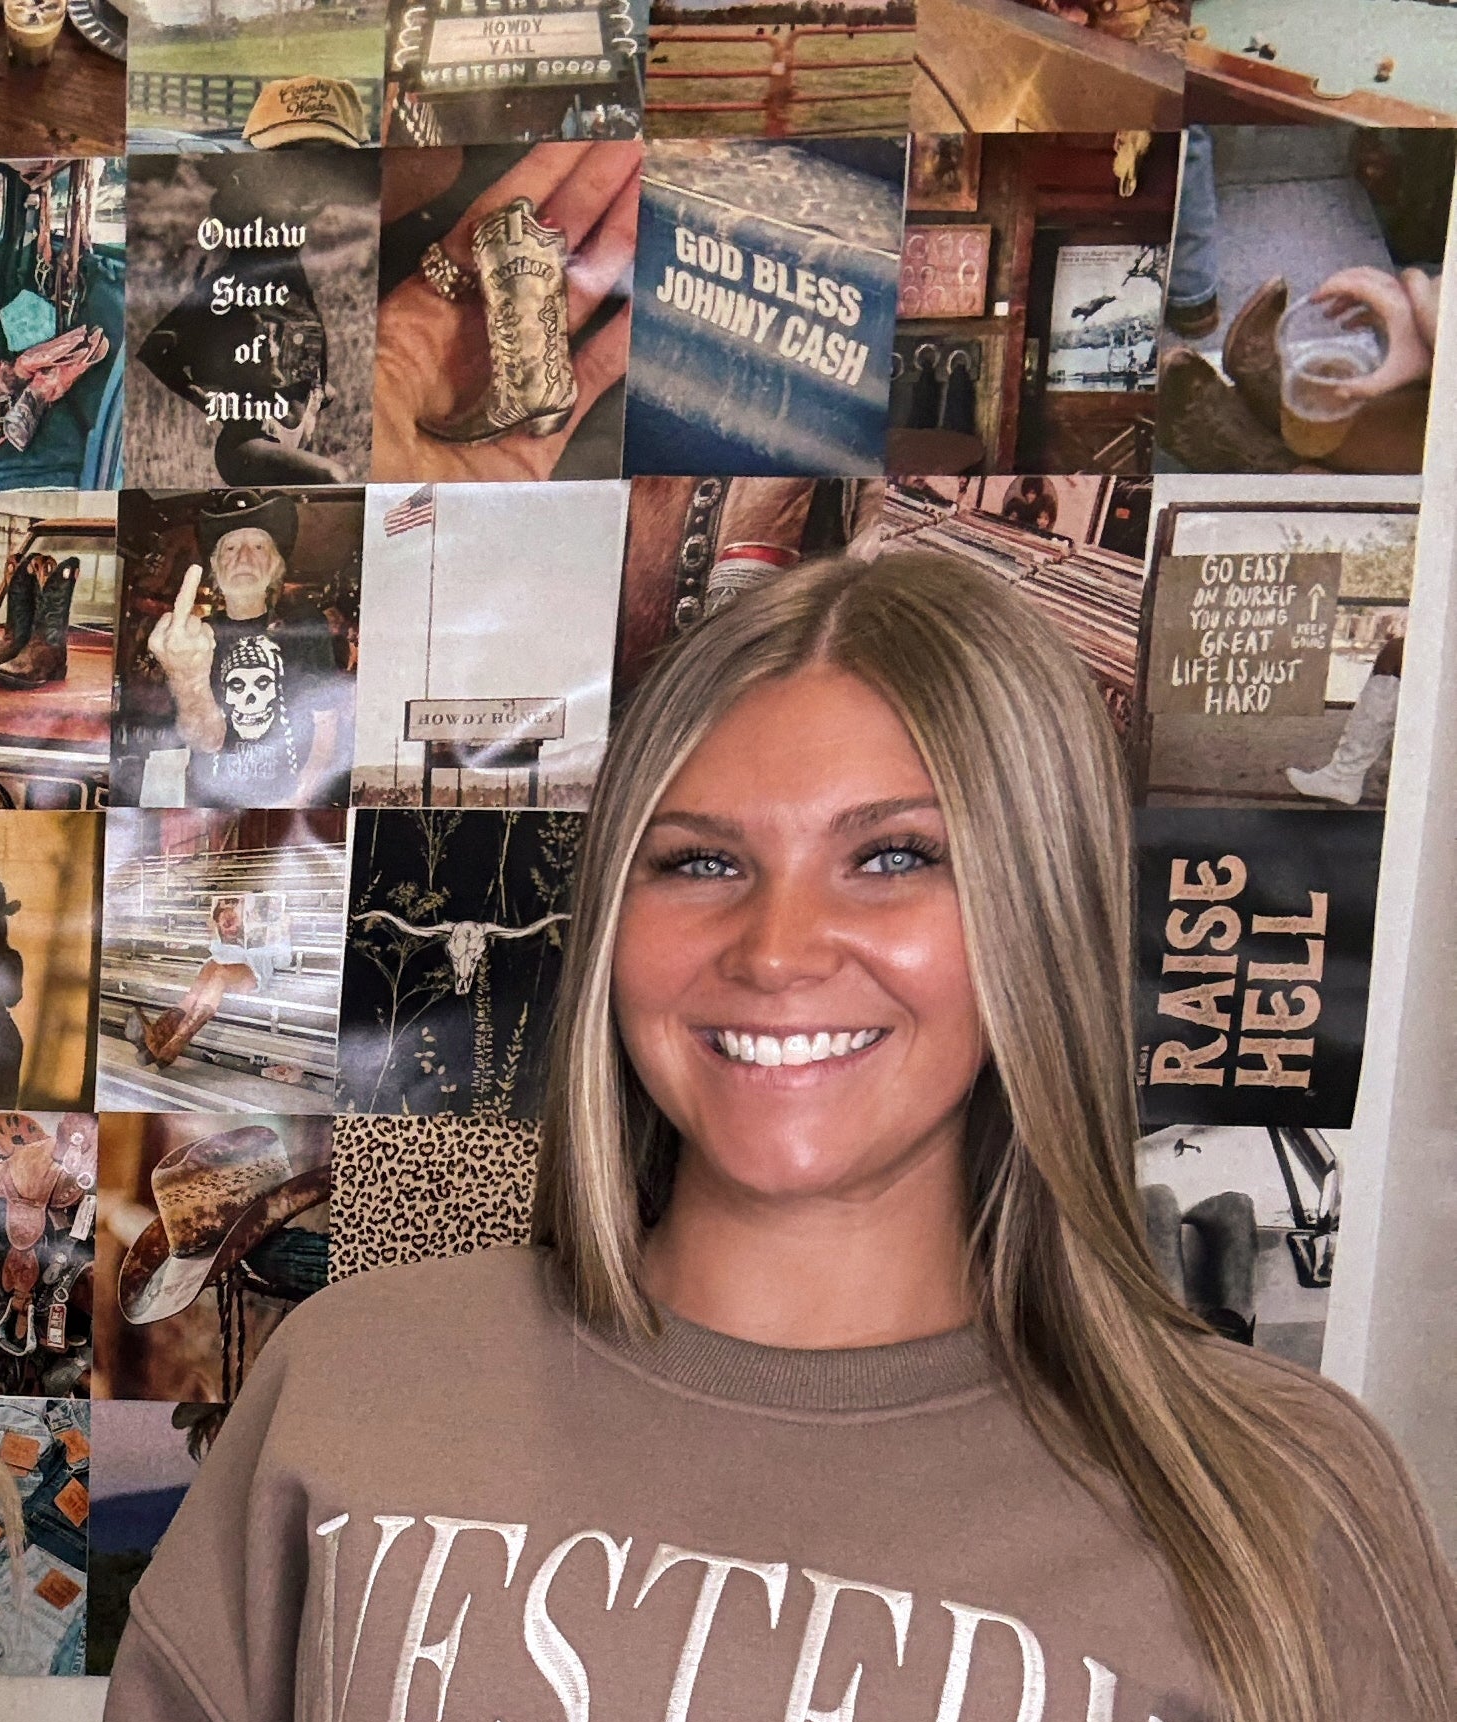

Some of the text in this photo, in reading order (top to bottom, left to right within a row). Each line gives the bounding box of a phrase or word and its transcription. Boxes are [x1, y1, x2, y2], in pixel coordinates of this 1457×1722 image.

[483, 17, 542, 36] HOWDY
[421, 59, 612, 84] WESTERN GOODS
[197, 216, 307, 250] Outlaw
[675, 226, 863, 327] GOD BLESS
[210, 274, 290, 316] State
[656, 265, 870, 386] JOHNNY CASH
[234, 334, 267, 364] of
[205, 391, 289, 426] Mind
[1201, 553, 1291, 586] GO EASY
[1193, 583, 1298, 608] ON YOURSELF
[1190, 608, 1288, 631] YOU R DOING
[1296, 623, 1328, 636] KEEP
[1200, 629, 1274, 658] GREAT
[1291, 635, 1326, 650] GOING
[1171, 654, 1304, 687] LIFE IS JUST
[1204, 684, 1272, 715] HARD
[418, 711, 556, 726] HOWDY HOY
[1150, 855, 1248, 1087] RAISE
[1235, 890, 1329, 1089] HELL
